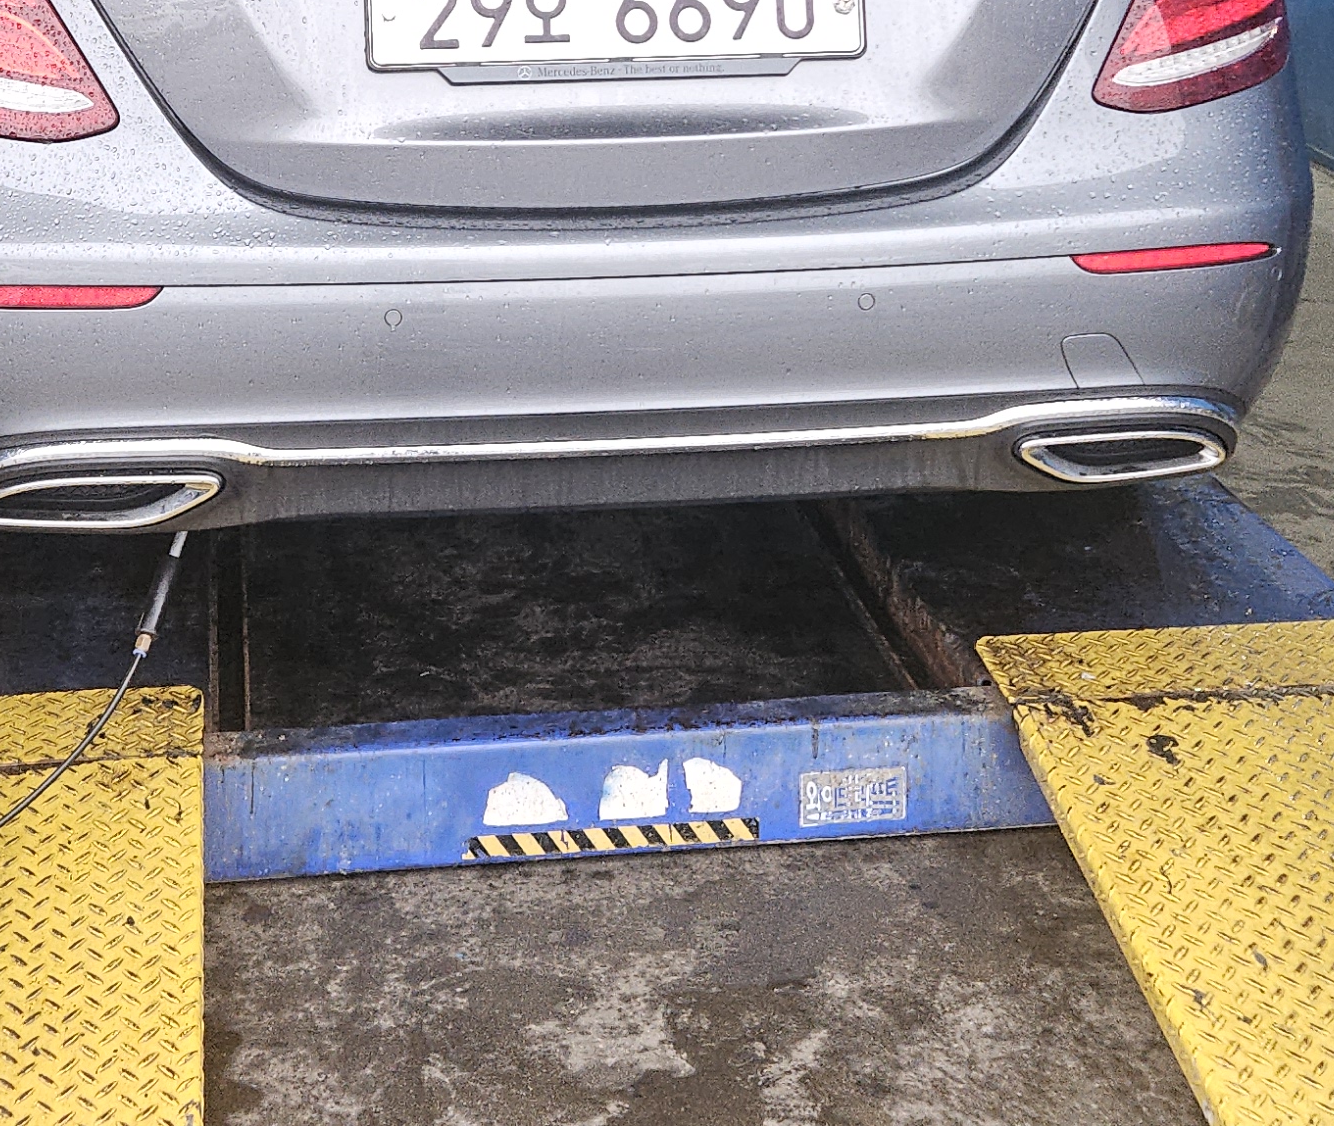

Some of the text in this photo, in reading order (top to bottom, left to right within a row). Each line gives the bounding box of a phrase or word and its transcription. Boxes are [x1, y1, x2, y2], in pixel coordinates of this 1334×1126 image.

[538, 66, 615, 77] Mercedes-Benz
[624, 66, 643, 75] The
[645, 64, 667, 74] best
[669, 65, 680, 74] or
